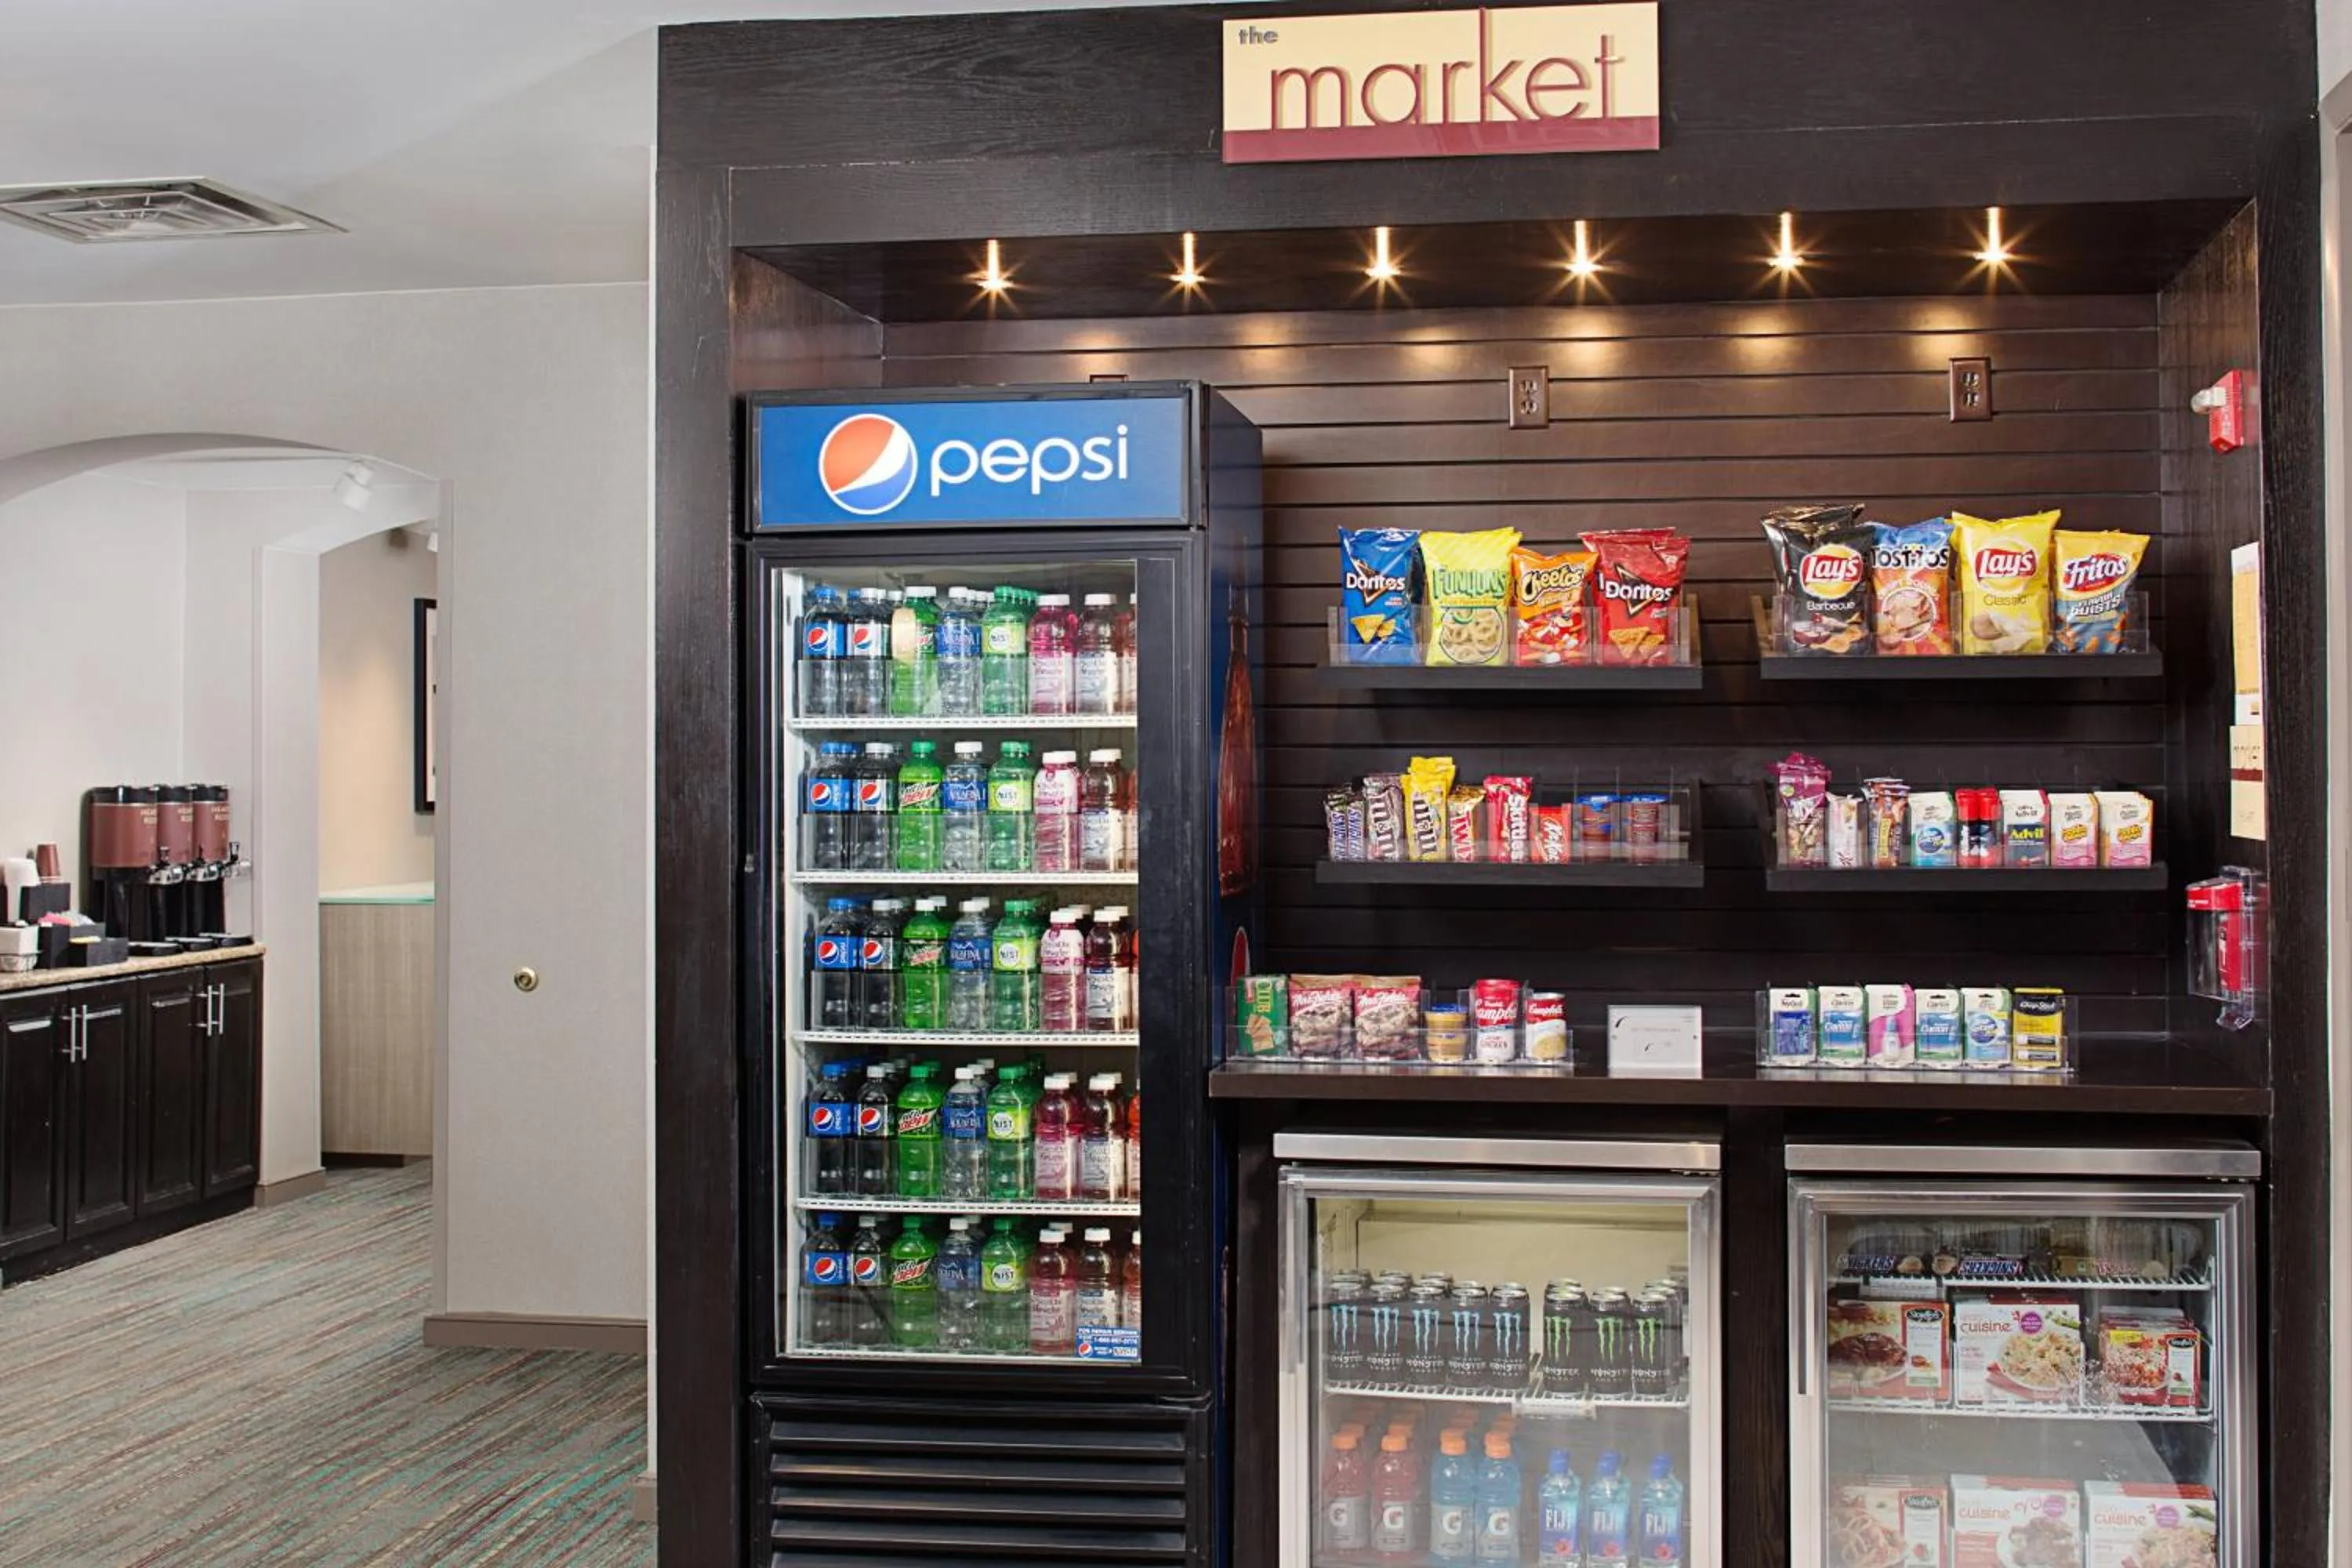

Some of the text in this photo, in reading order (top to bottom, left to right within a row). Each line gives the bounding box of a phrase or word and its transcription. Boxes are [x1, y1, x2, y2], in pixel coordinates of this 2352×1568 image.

[1239, 26, 1279, 45] the
[1271, 6, 1624, 130] market
[931, 424, 1128, 497] pepsi
[1805, 555, 1860, 584] Lay's
[1978, 549, 2034, 579] Lay's
[2063, 554, 2129, 590] Fritos
[1345, 572, 1406, 590] Doritos
[1522, 563, 1585, 604] Cheetos
[1605, 581, 1674, 602] Doritos
[1983, 593, 2027, 607] Classic
[1806, 601, 1856, 612] Barbecue
[1508, 793, 1527, 862] Skittles
[2009, 827, 2044, 840] Advil
[1959, 1320, 2012, 1334] cuisine
[1959, 1506, 2010, 1519] cuisine
[2094, 1512, 2147, 1526] cuisine
